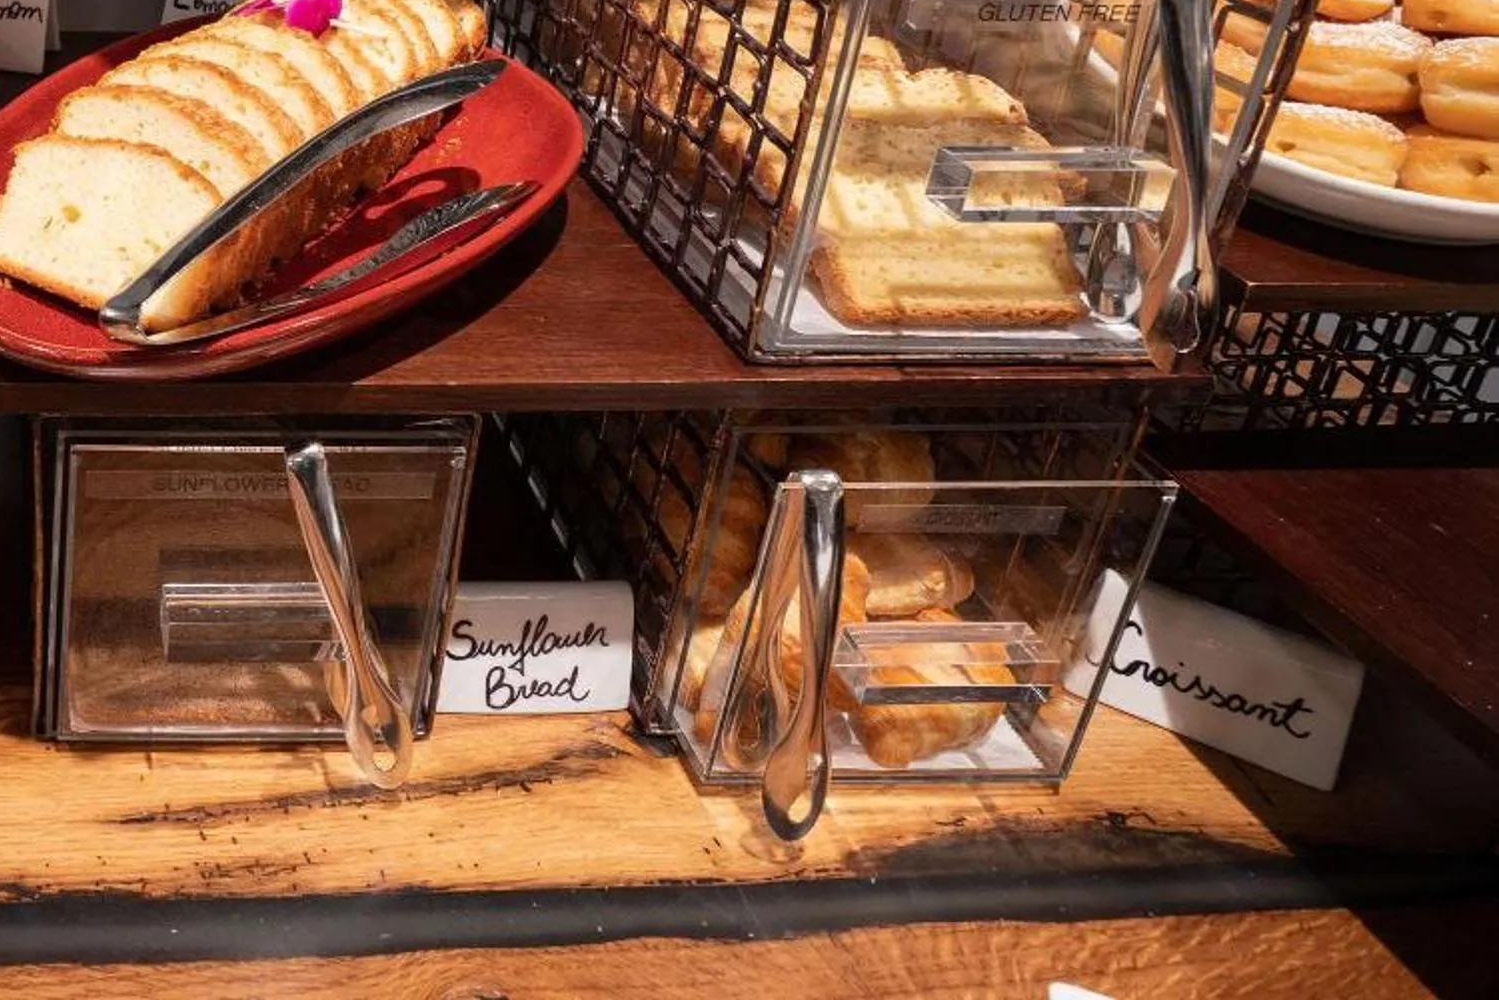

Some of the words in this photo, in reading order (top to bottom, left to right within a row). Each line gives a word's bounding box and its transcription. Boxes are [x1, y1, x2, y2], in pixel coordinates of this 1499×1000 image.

[977, 1, 1072, 22] GLUTEN
[1078, 3, 1141, 22] FREE
[446, 613, 610, 677] Sunflower
[485, 665, 591, 710] Bread
